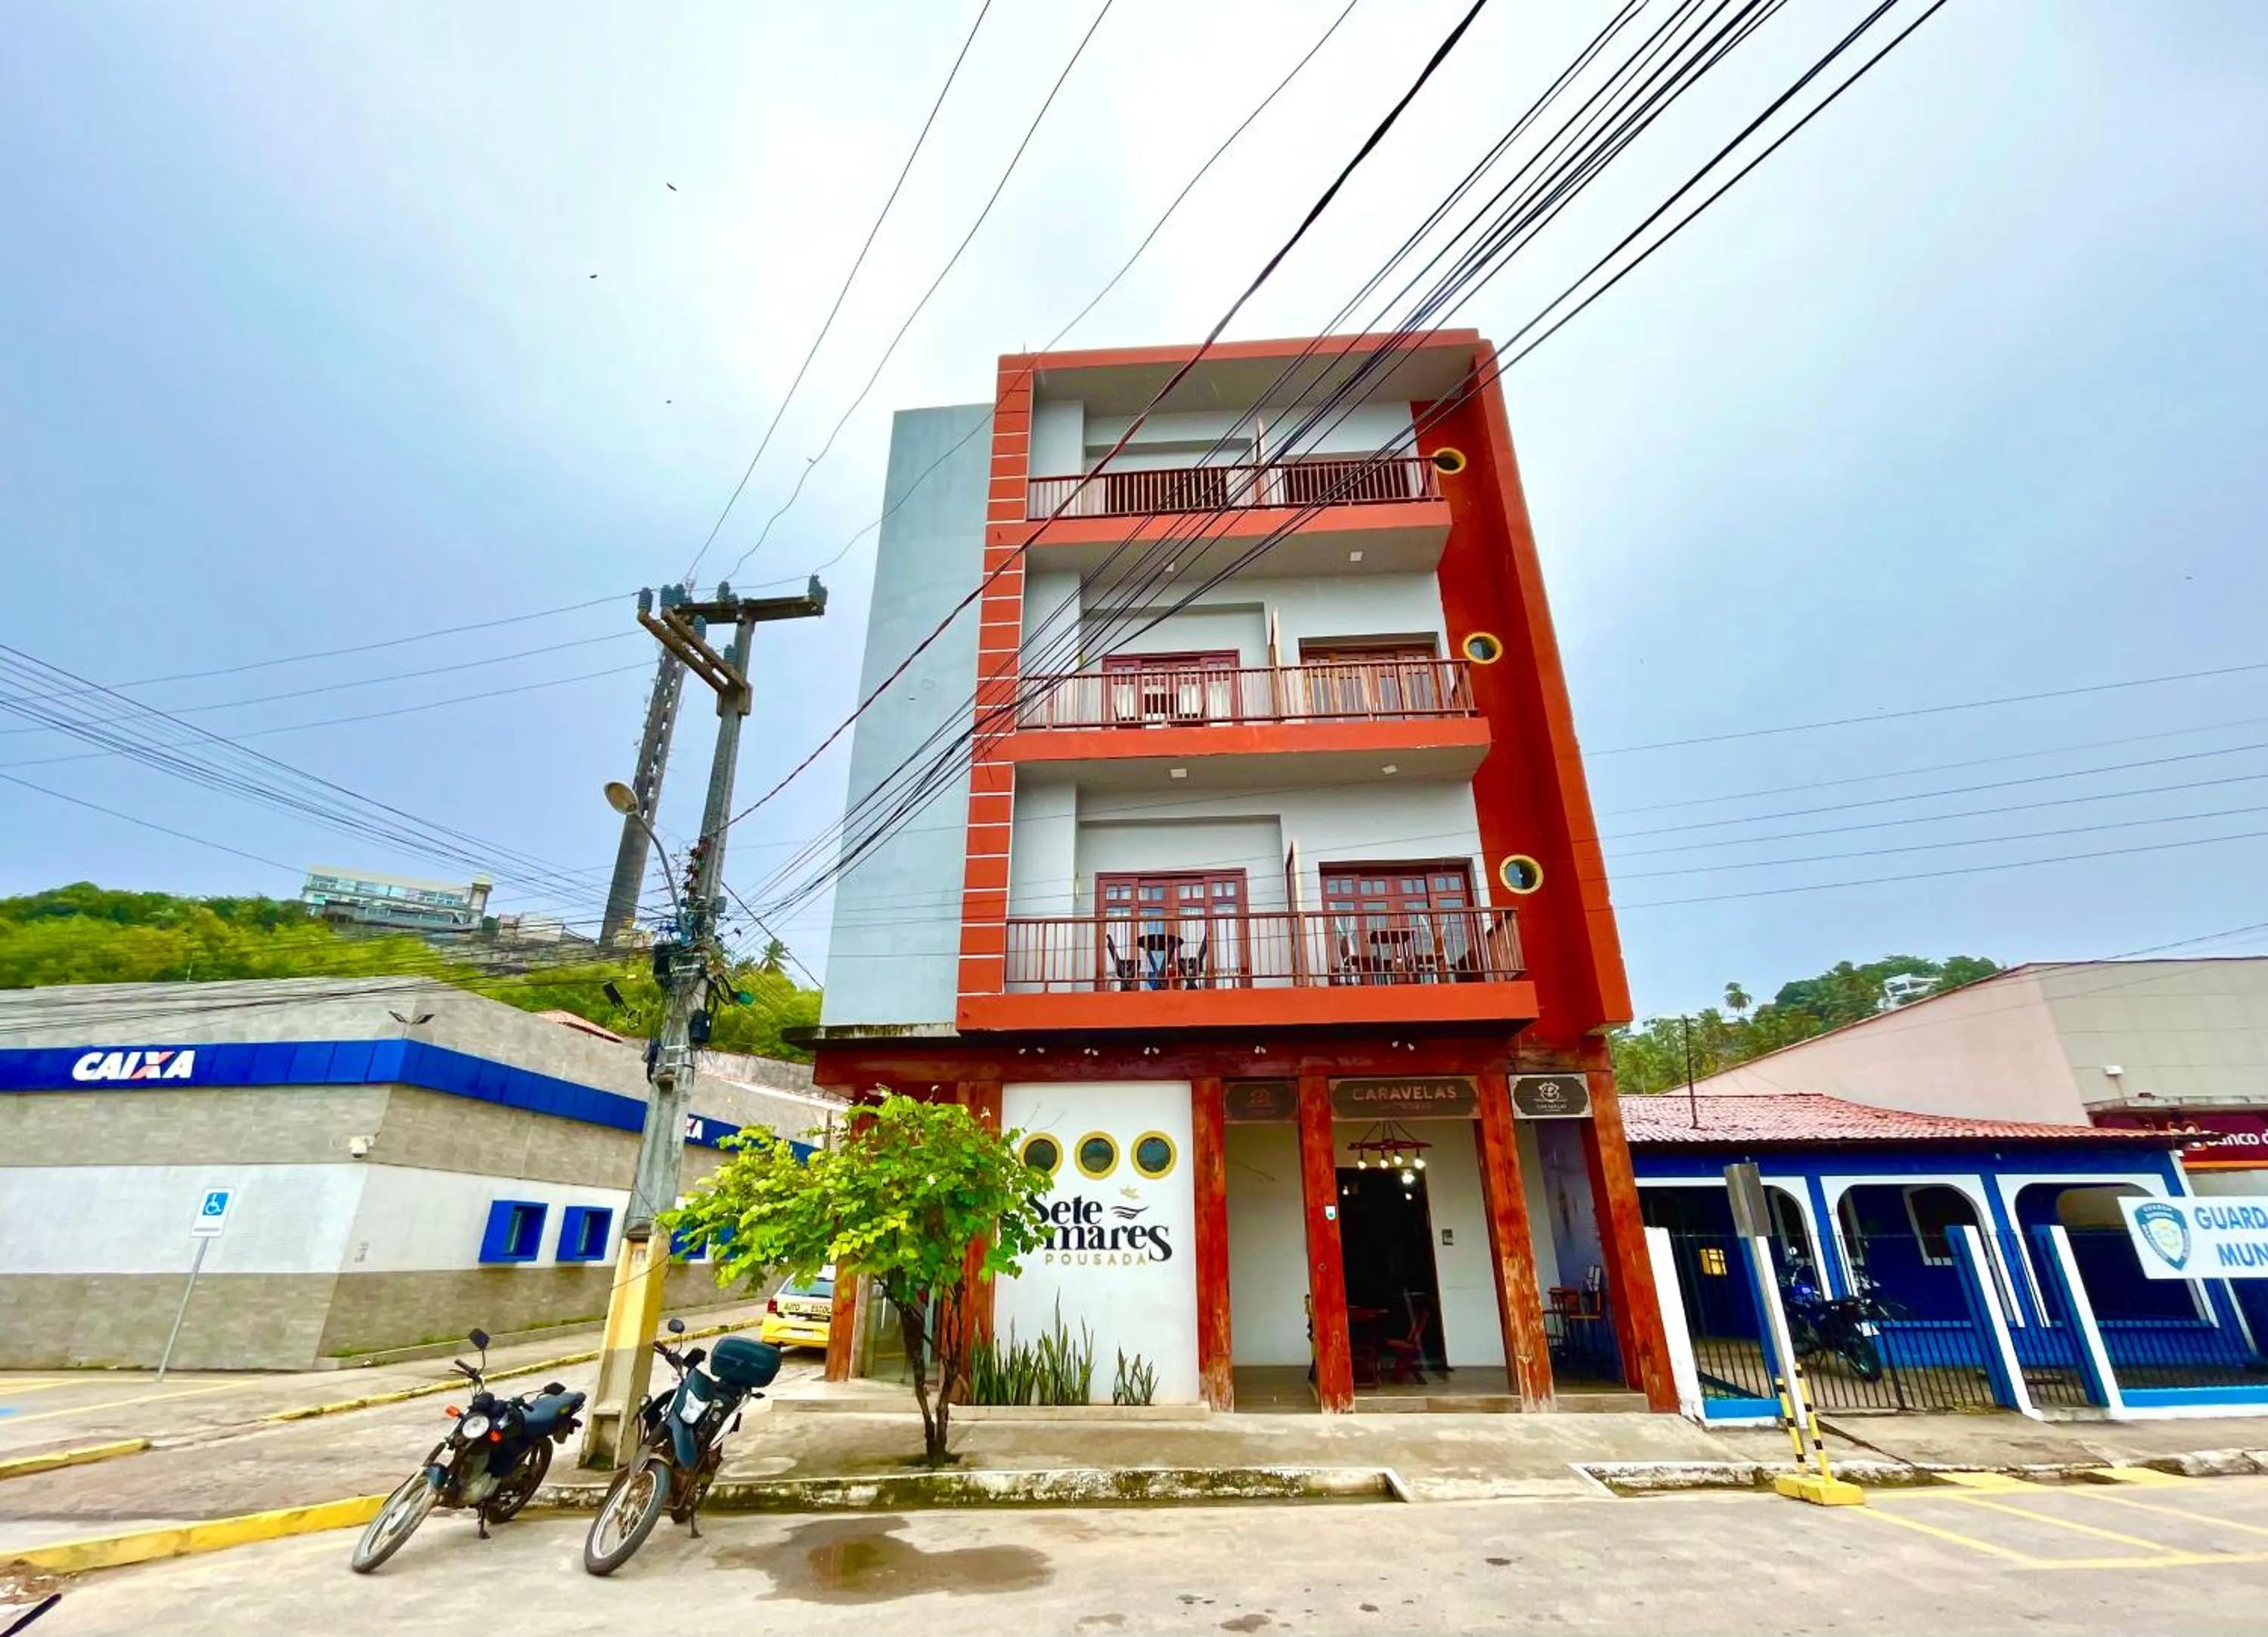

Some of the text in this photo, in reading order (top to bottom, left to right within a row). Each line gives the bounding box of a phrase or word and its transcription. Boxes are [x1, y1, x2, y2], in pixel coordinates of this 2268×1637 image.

[72, 1050, 196, 1082] CAIXA
[1352, 1085, 1458, 1101] CARAVELAS
[1026, 1191, 1104, 1225] Sete
[2194, 1205, 2268, 1230] GUARD
[1044, 1225, 1173, 1262] mares
[1045, 1253, 1148, 1266] POUSADA
